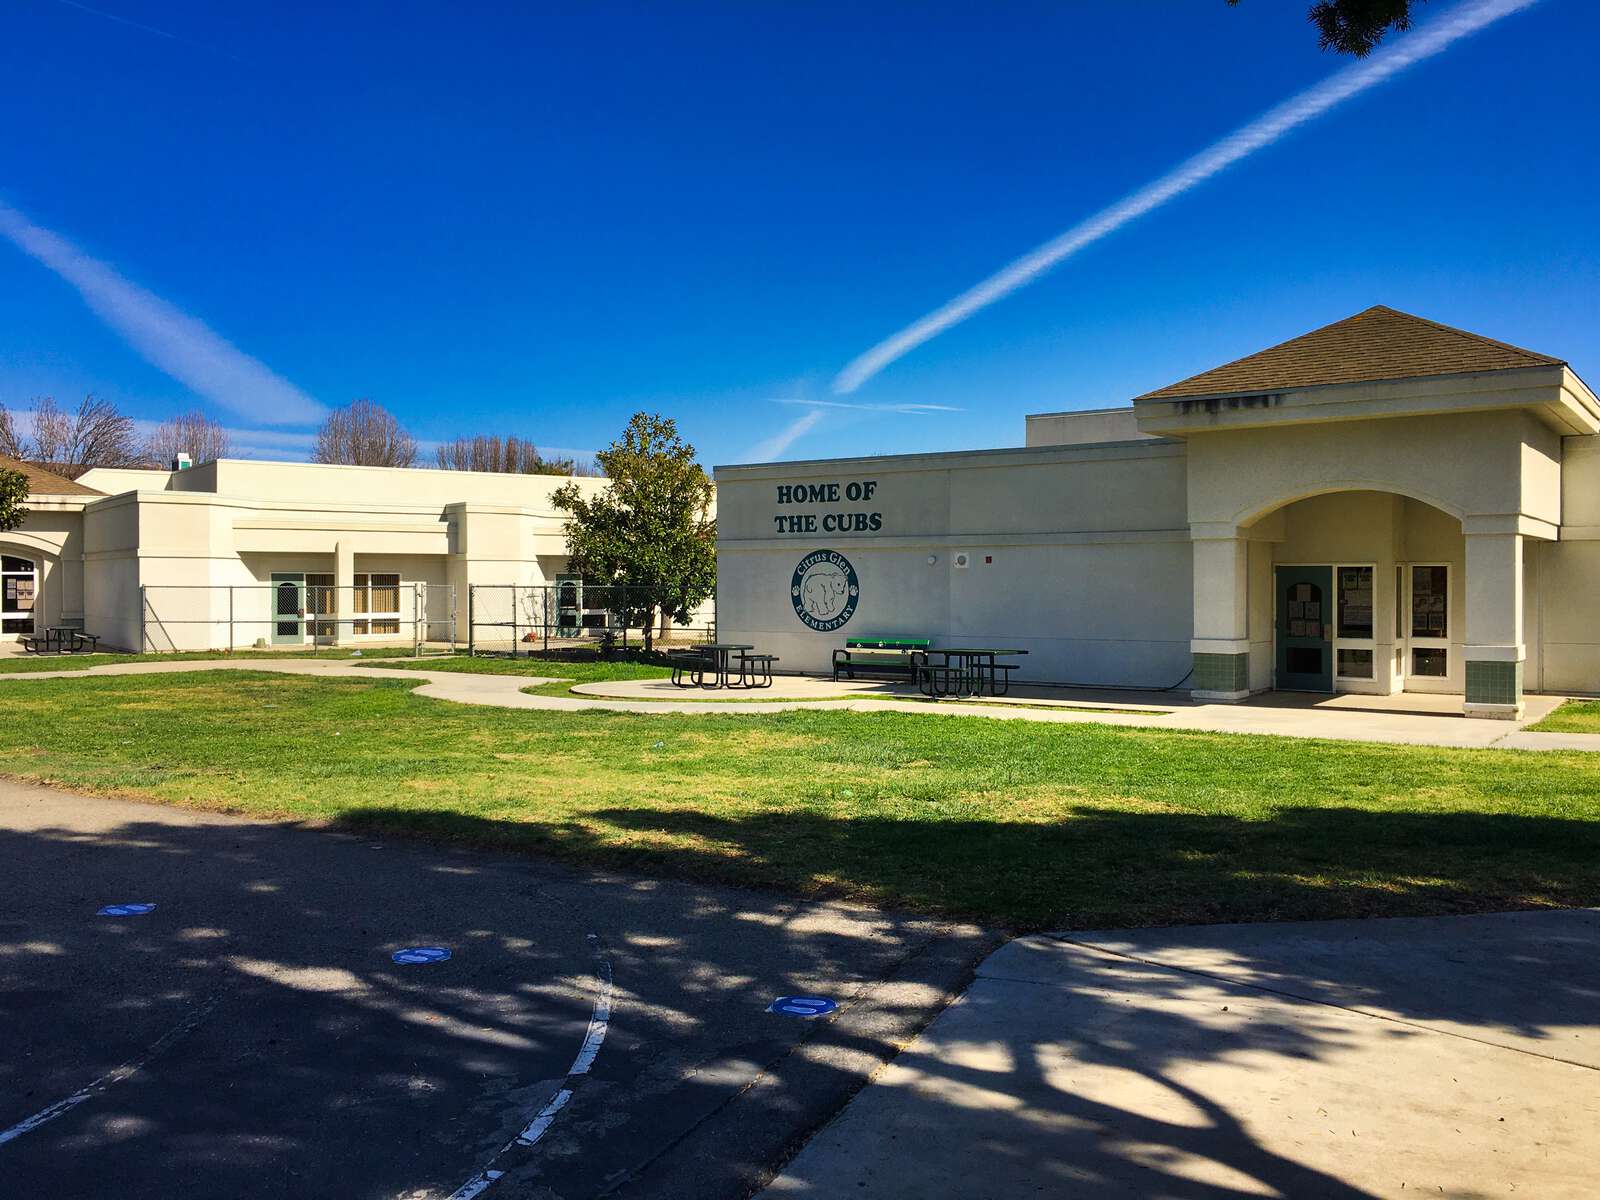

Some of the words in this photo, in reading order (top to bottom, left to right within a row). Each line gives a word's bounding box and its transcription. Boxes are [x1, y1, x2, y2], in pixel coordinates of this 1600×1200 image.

[777, 483, 840, 504] HOME
[846, 481, 877, 501] OF
[774, 515, 817, 533] THE
[822, 512, 882, 532] CUBS
[797, 553, 827, 576] Citrus
[829, 552, 851, 575] Glen
[796, 604, 854, 630] ELEMENTARY
